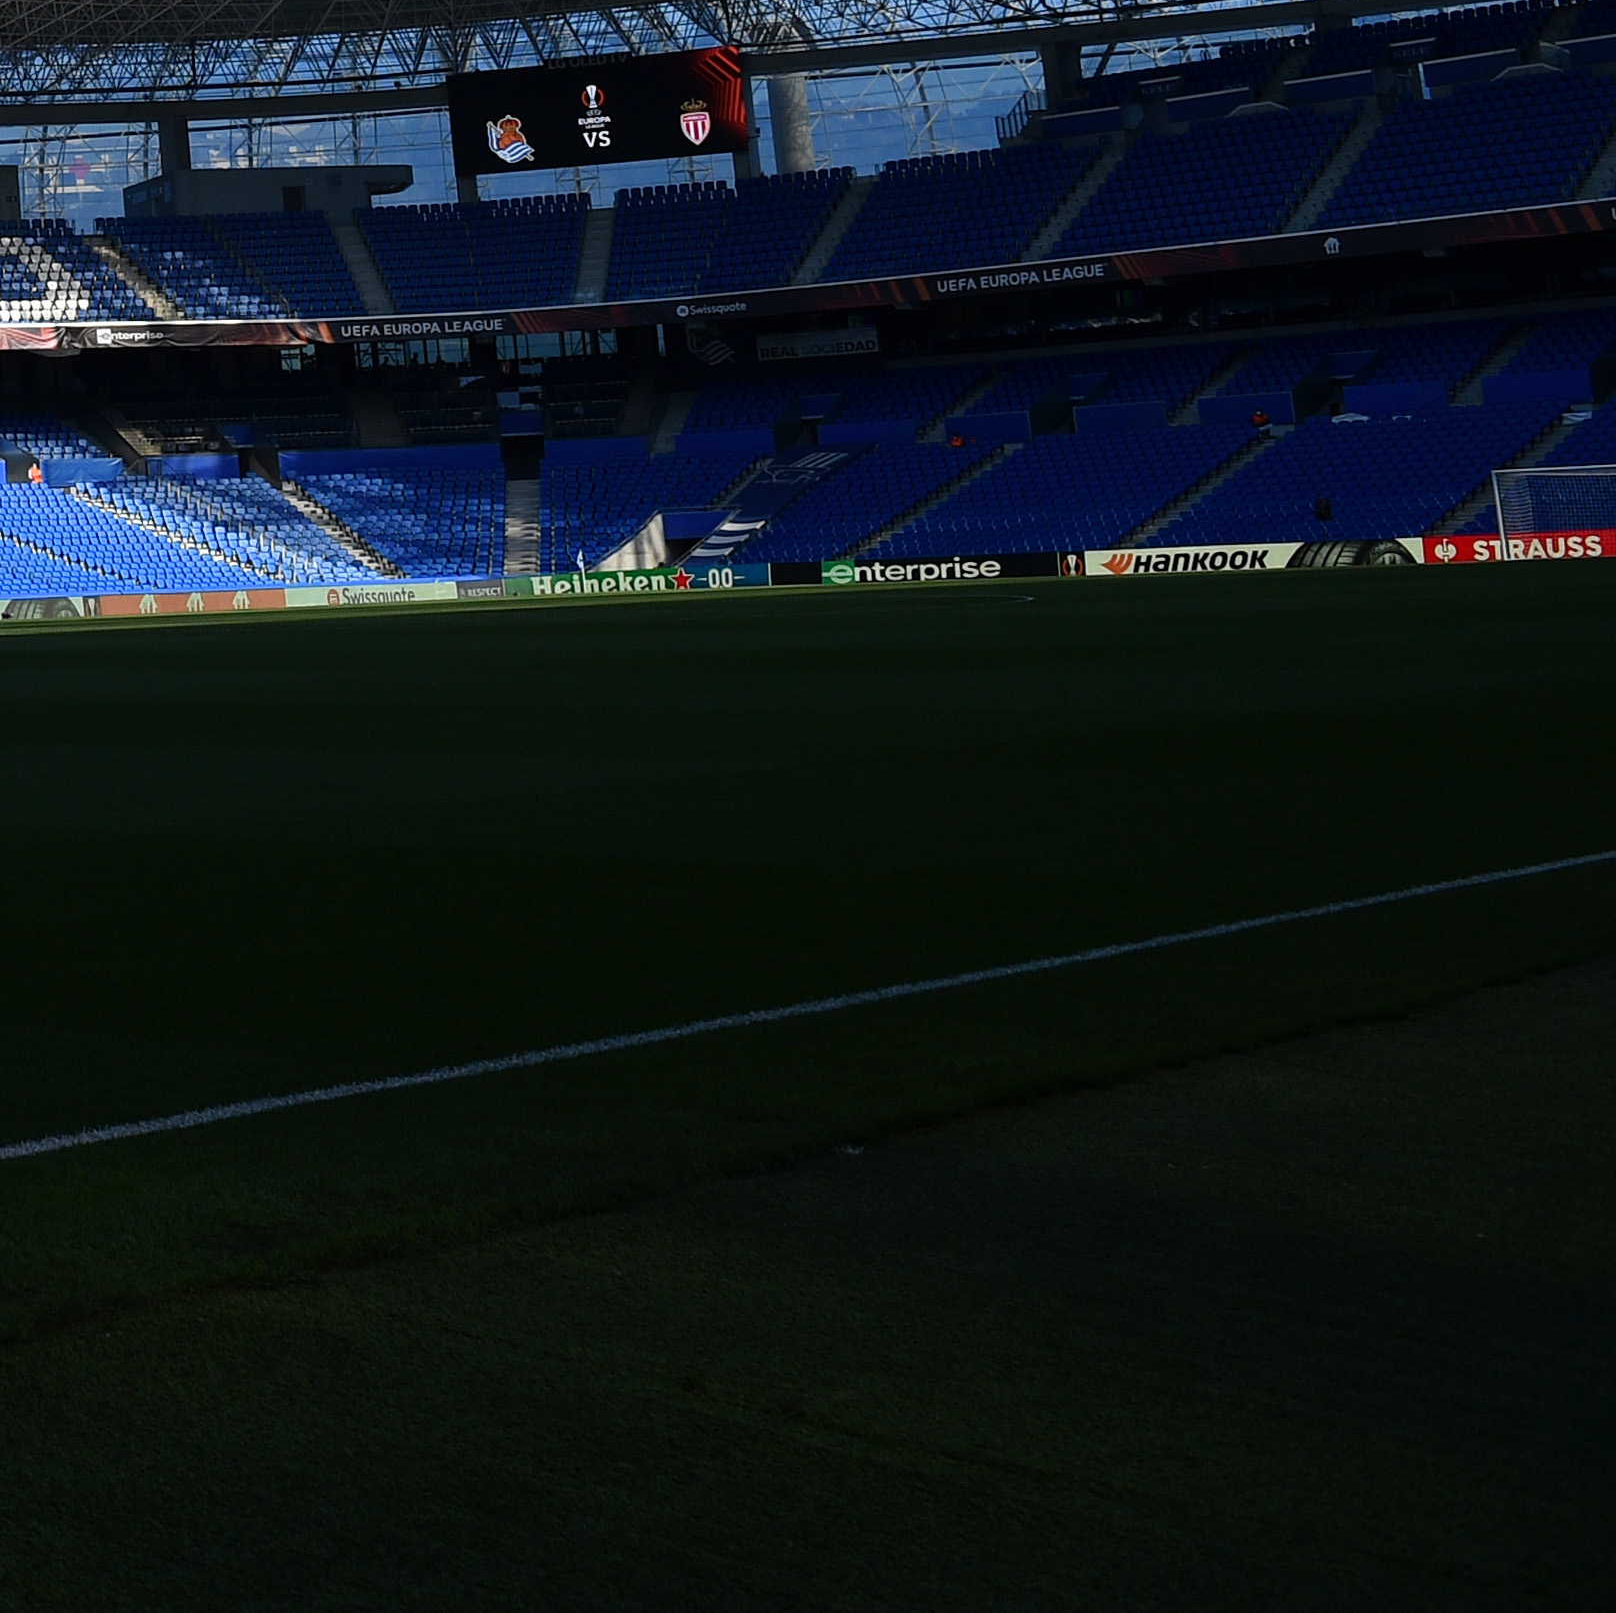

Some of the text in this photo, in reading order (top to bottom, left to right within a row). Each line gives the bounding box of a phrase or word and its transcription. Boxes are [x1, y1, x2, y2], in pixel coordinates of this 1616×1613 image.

[569, 54, 607, 68] OLED
[582, 130, 611, 148] VS
[936, 264, 1106, 294] UEFA EUROPA LEAGUE
[689, 301, 748, 316] Swissquote
[98, 329, 164, 342] enterprise
[340, 318, 504, 337] UEFA EUROPA LEAGUE
[760, 340, 876, 359] REAL SOCIEDAD
[1473, 535, 1603, 562] STRAUSS
[826, 556, 1001, 584] enterprise
[468, 586, 502, 598] RESPECT
[530, 571, 667, 595] Heineken
[342, 587, 416, 605] Swissquote
